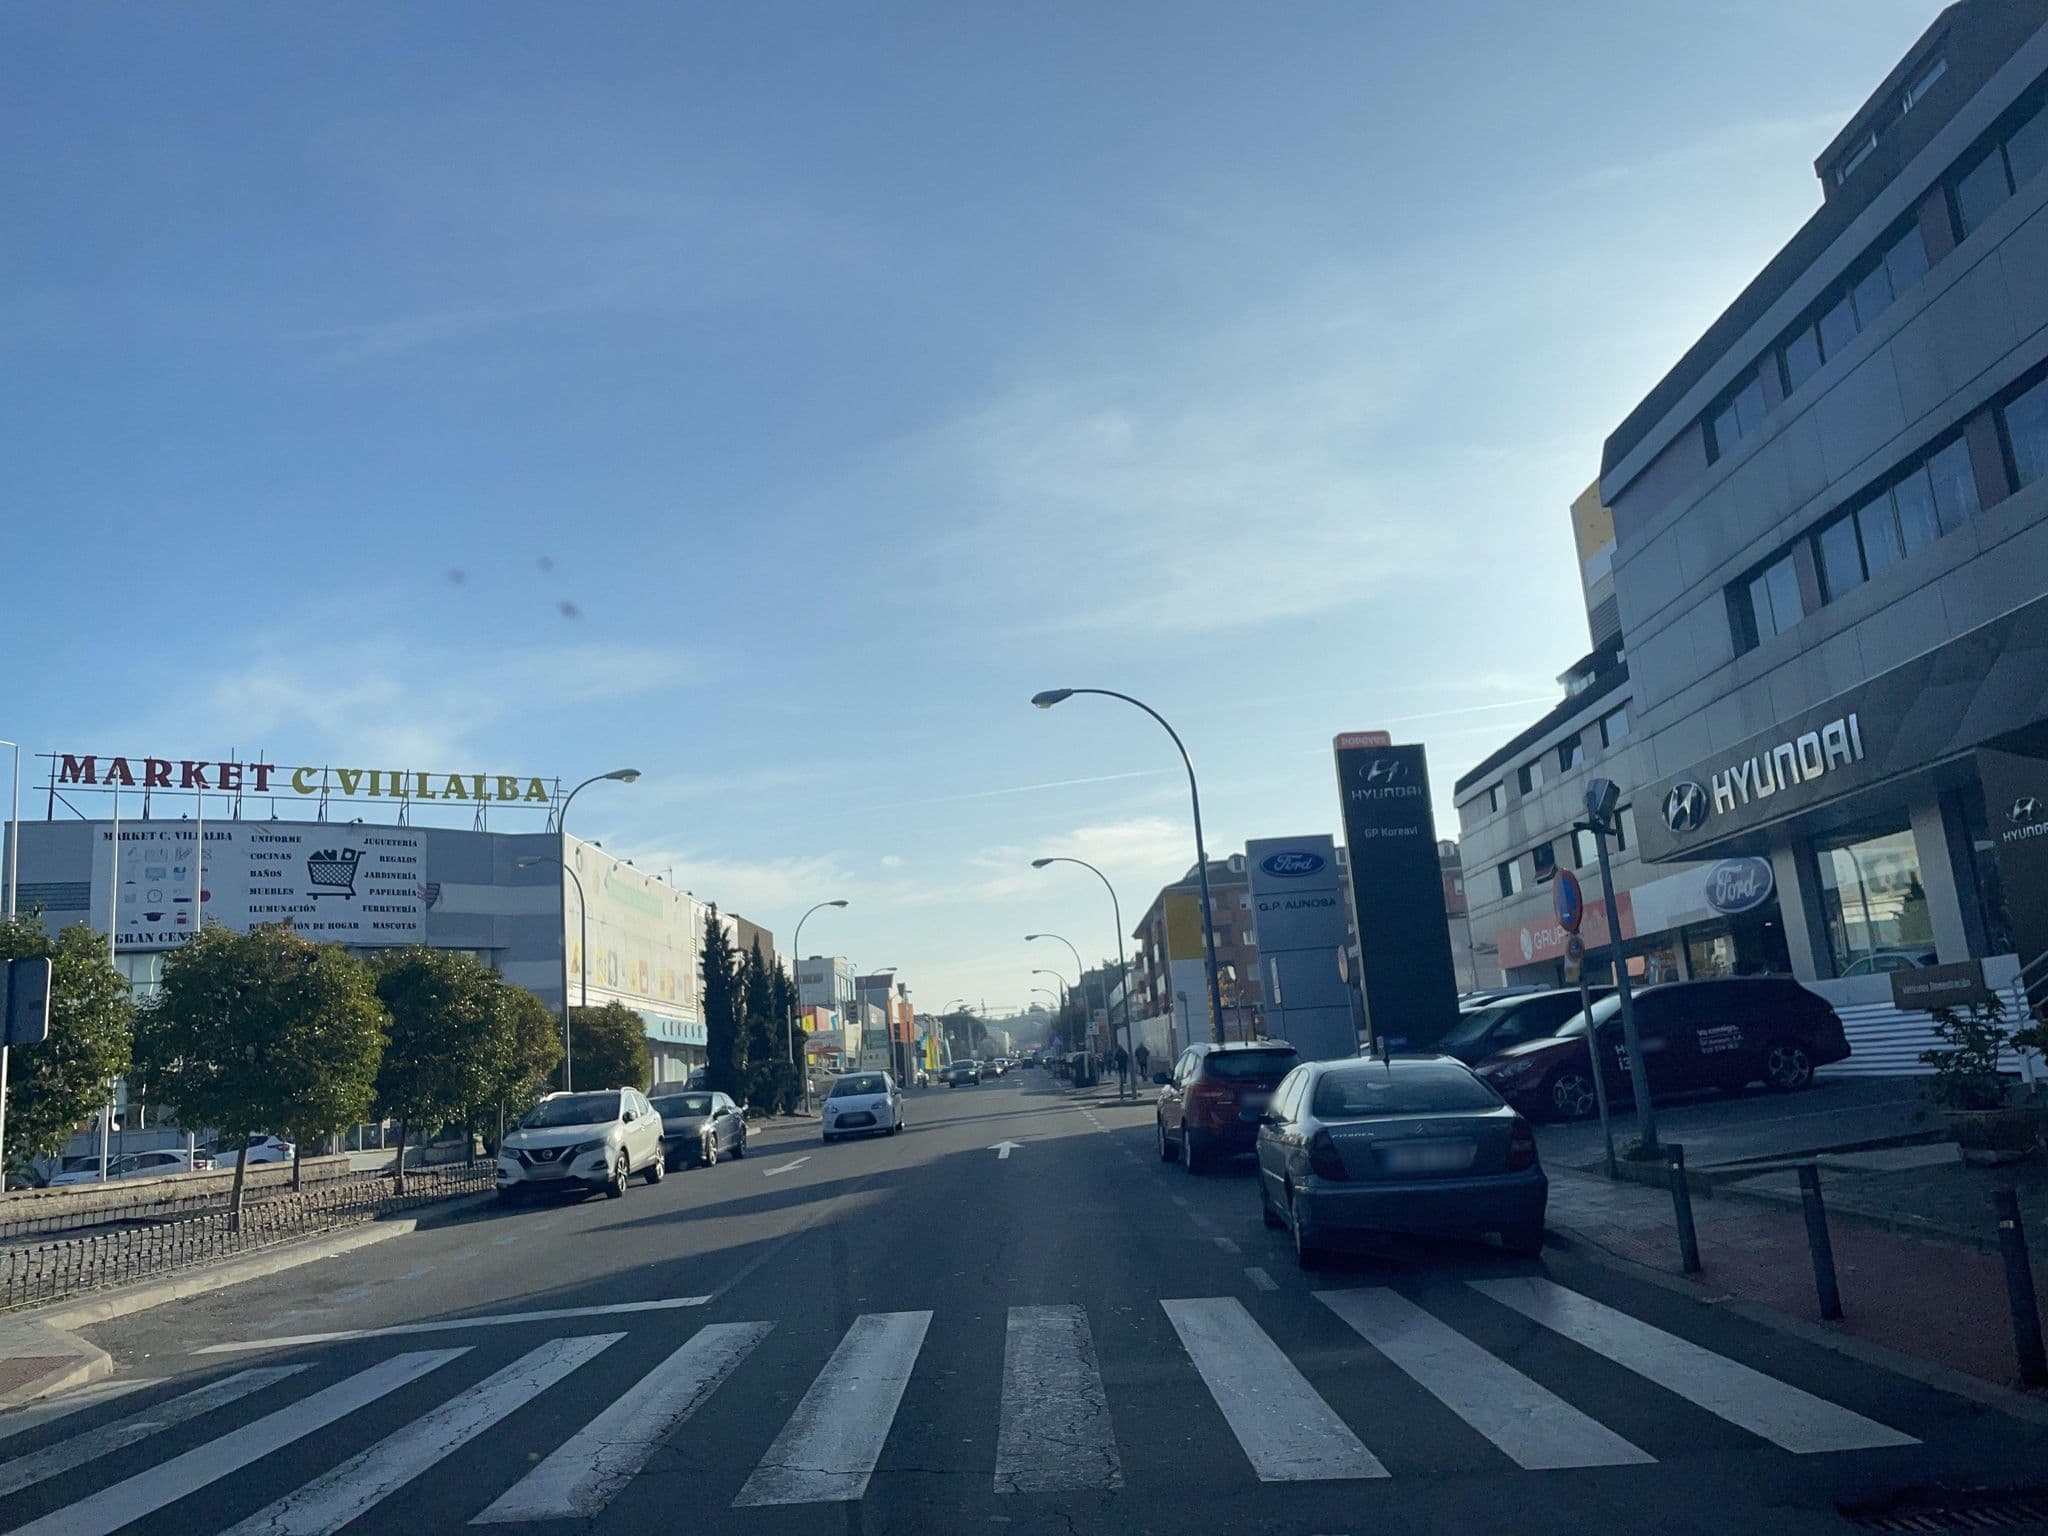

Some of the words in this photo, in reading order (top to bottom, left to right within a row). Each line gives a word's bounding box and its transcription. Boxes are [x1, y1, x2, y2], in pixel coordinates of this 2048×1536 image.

[1711, 713, 1864, 815] HYUNDAI
[58, 754, 275, 792] MARKET
[1351, 785, 1423, 800] HYUNDAI
[103, 831, 156, 840] MARKET
[2003, 822, 2048, 842] HYUNDA
[251, 835, 302, 844] UNIFORME
[250, 852, 292, 860] COCINAS
[379, 855, 417, 864] REGALOS
[250, 868, 282, 878] BAÑOS
[363, 871, 417, 882] JARDINERÍA
[1716, 864, 1761, 906] Ford
[249, 887, 294, 896] MUEBLES
[369, 887, 417, 898] PAPELERÍA
[362, 904, 417, 914] FERRETERÍA
[313, 922, 326, 930] DE
[327, 922, 360, 930] HOGAR
[372, 921, 417, 930] MASCOTAS
